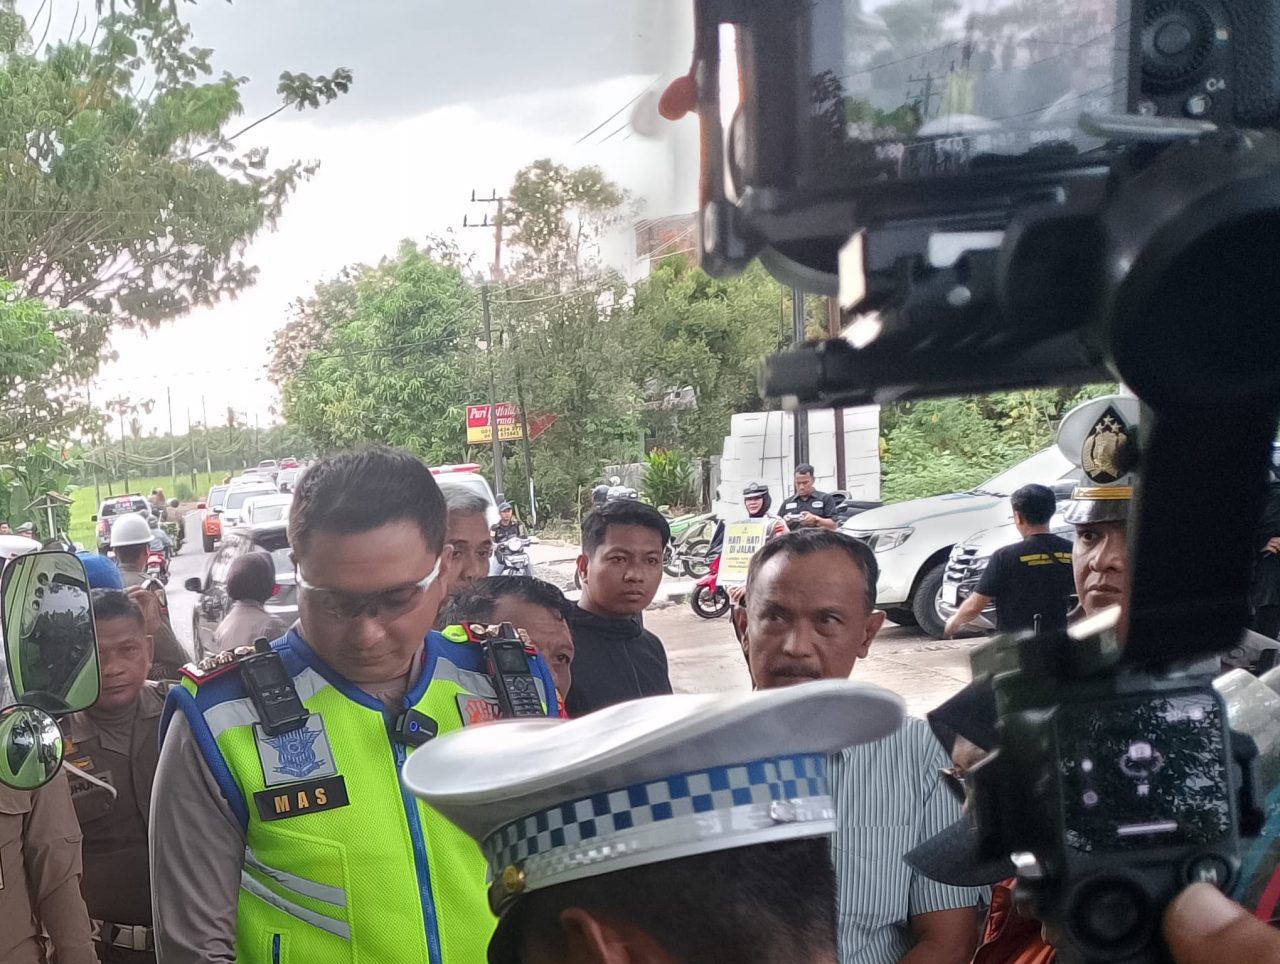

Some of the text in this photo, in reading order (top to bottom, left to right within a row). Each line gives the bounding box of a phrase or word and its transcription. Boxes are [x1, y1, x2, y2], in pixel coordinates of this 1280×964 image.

[469, 406, 488, 419] Puri
[728, 535, 741, 544] HATI
[746, 535, 760, 544] HATI
[737, 545, 756, 554] JALAN
[273, 787, 328, 814] MAS
